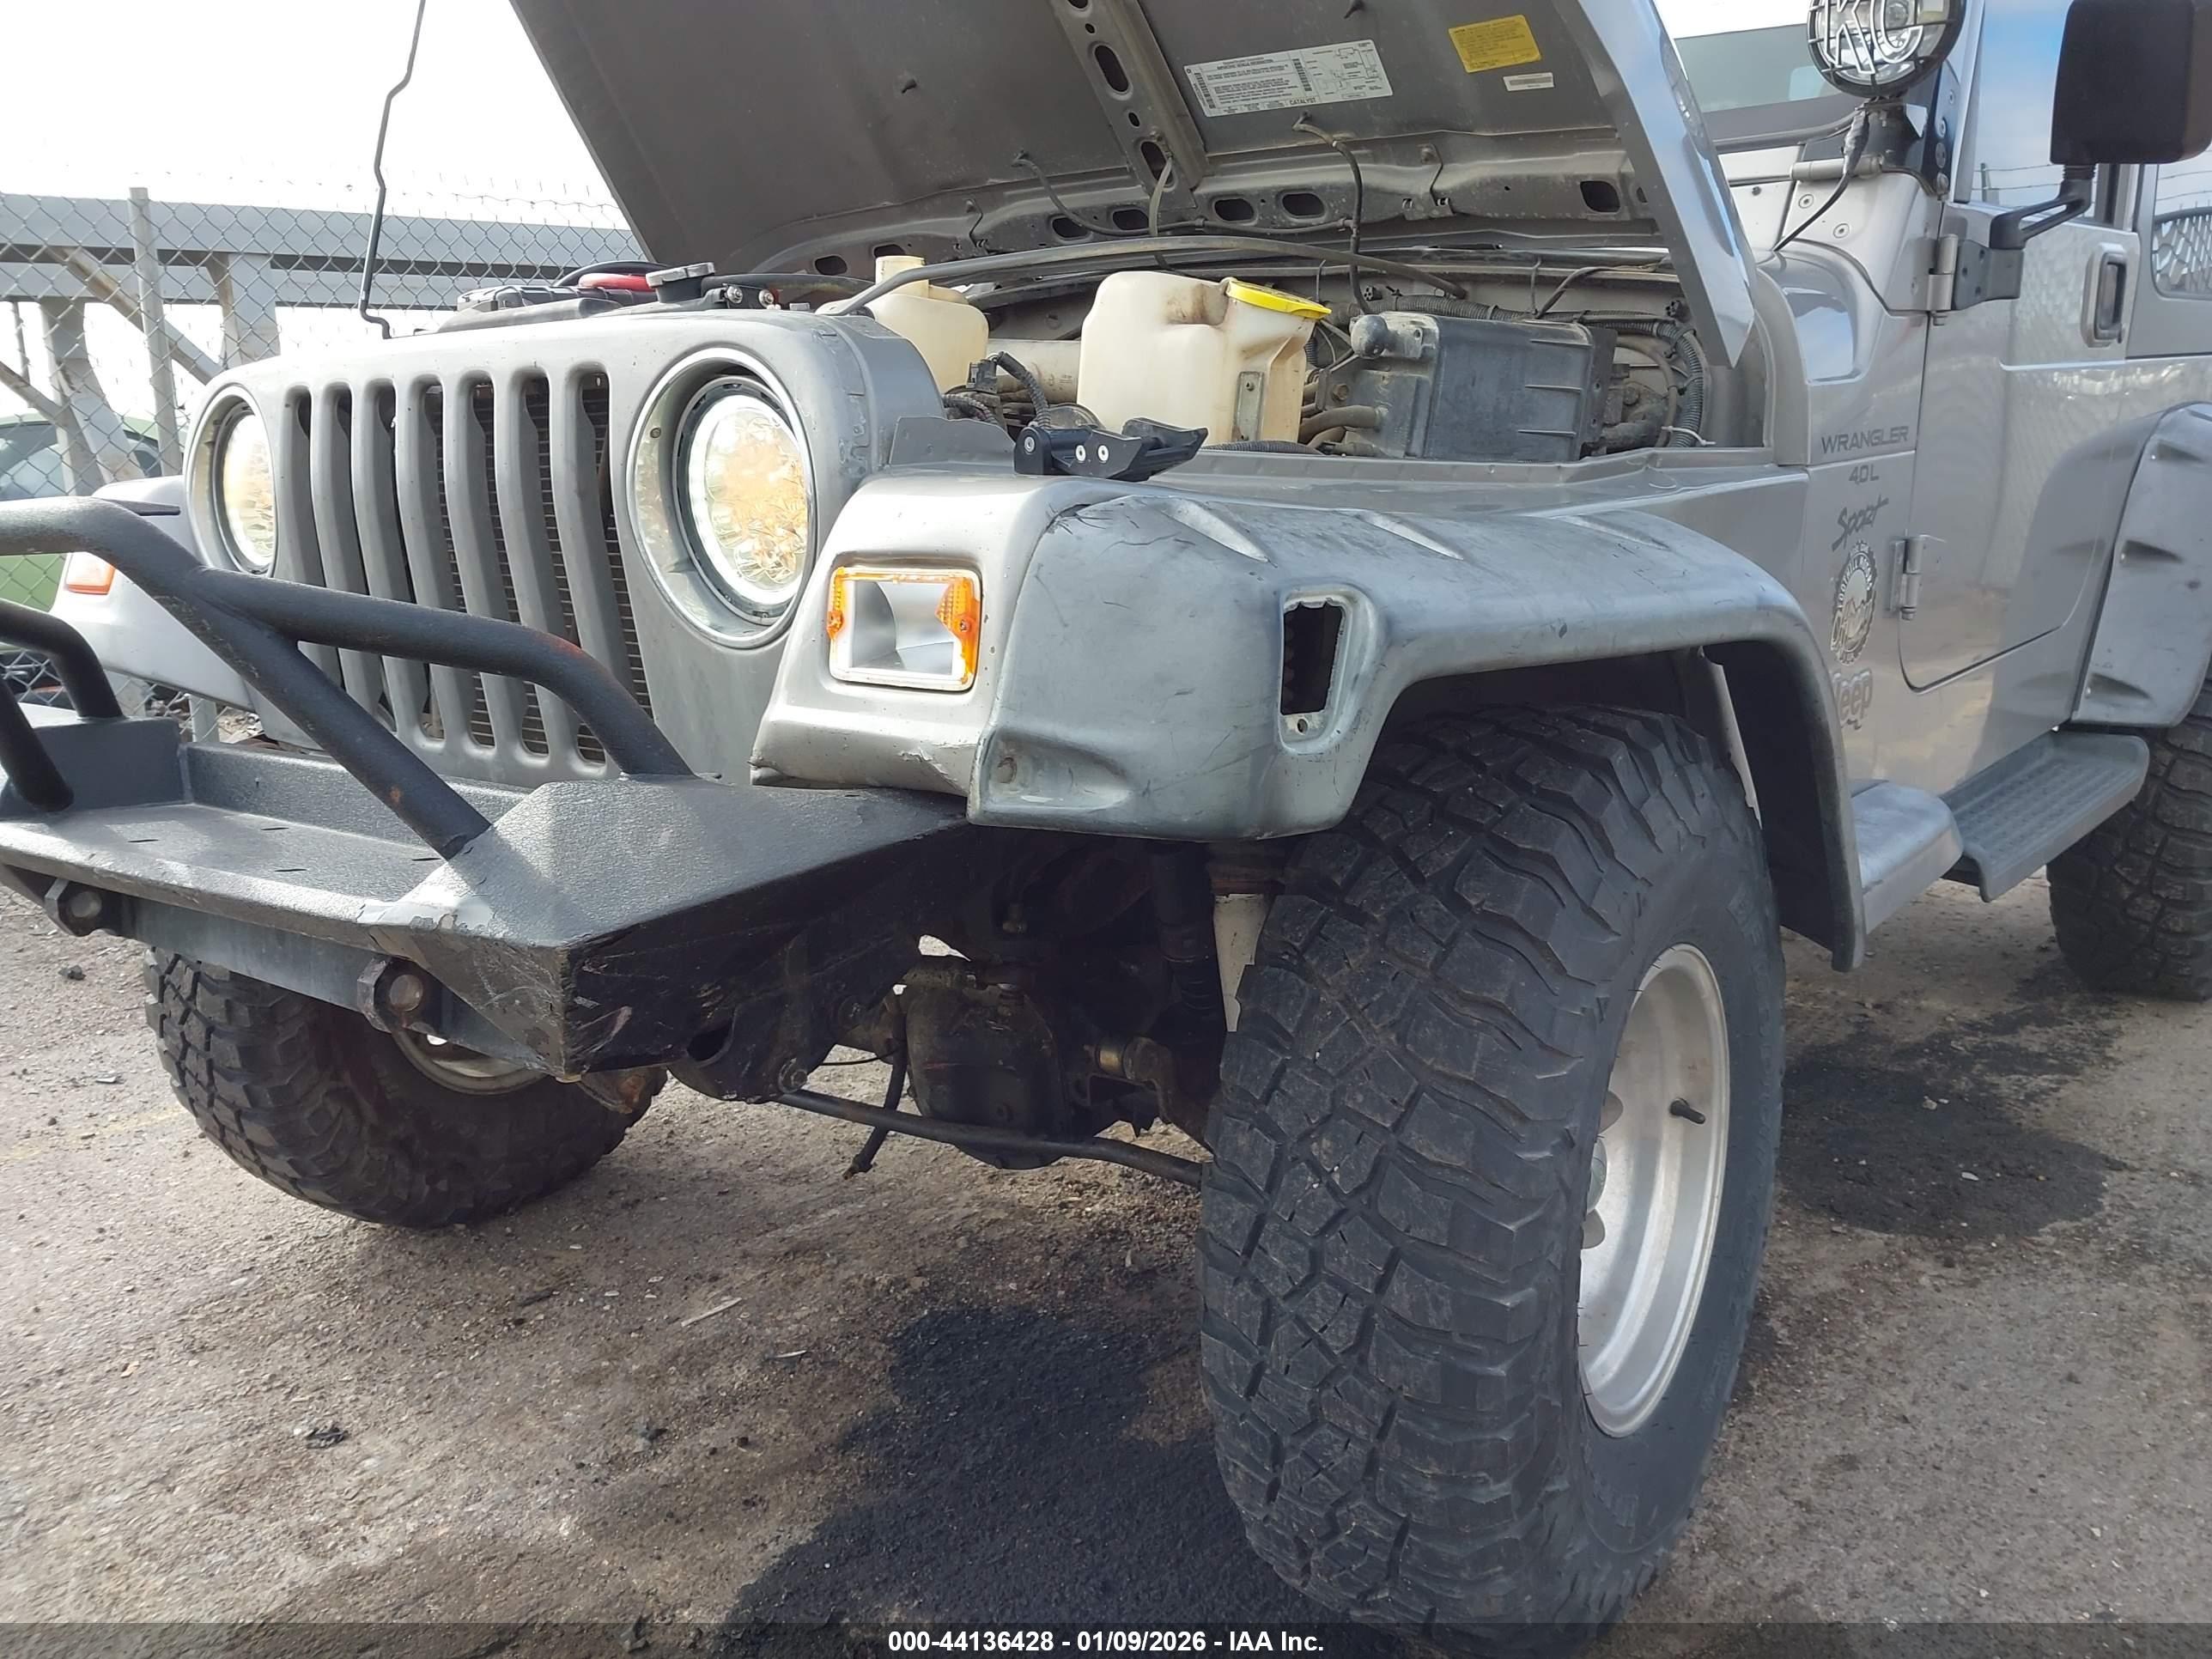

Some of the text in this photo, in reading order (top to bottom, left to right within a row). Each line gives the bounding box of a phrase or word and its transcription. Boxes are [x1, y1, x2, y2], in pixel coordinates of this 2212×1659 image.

[1825, 0, 1924, 75] KC
[1820, 425, 1909, 454] WRANGLER
[1831, 494, 1890, 551] Sport
